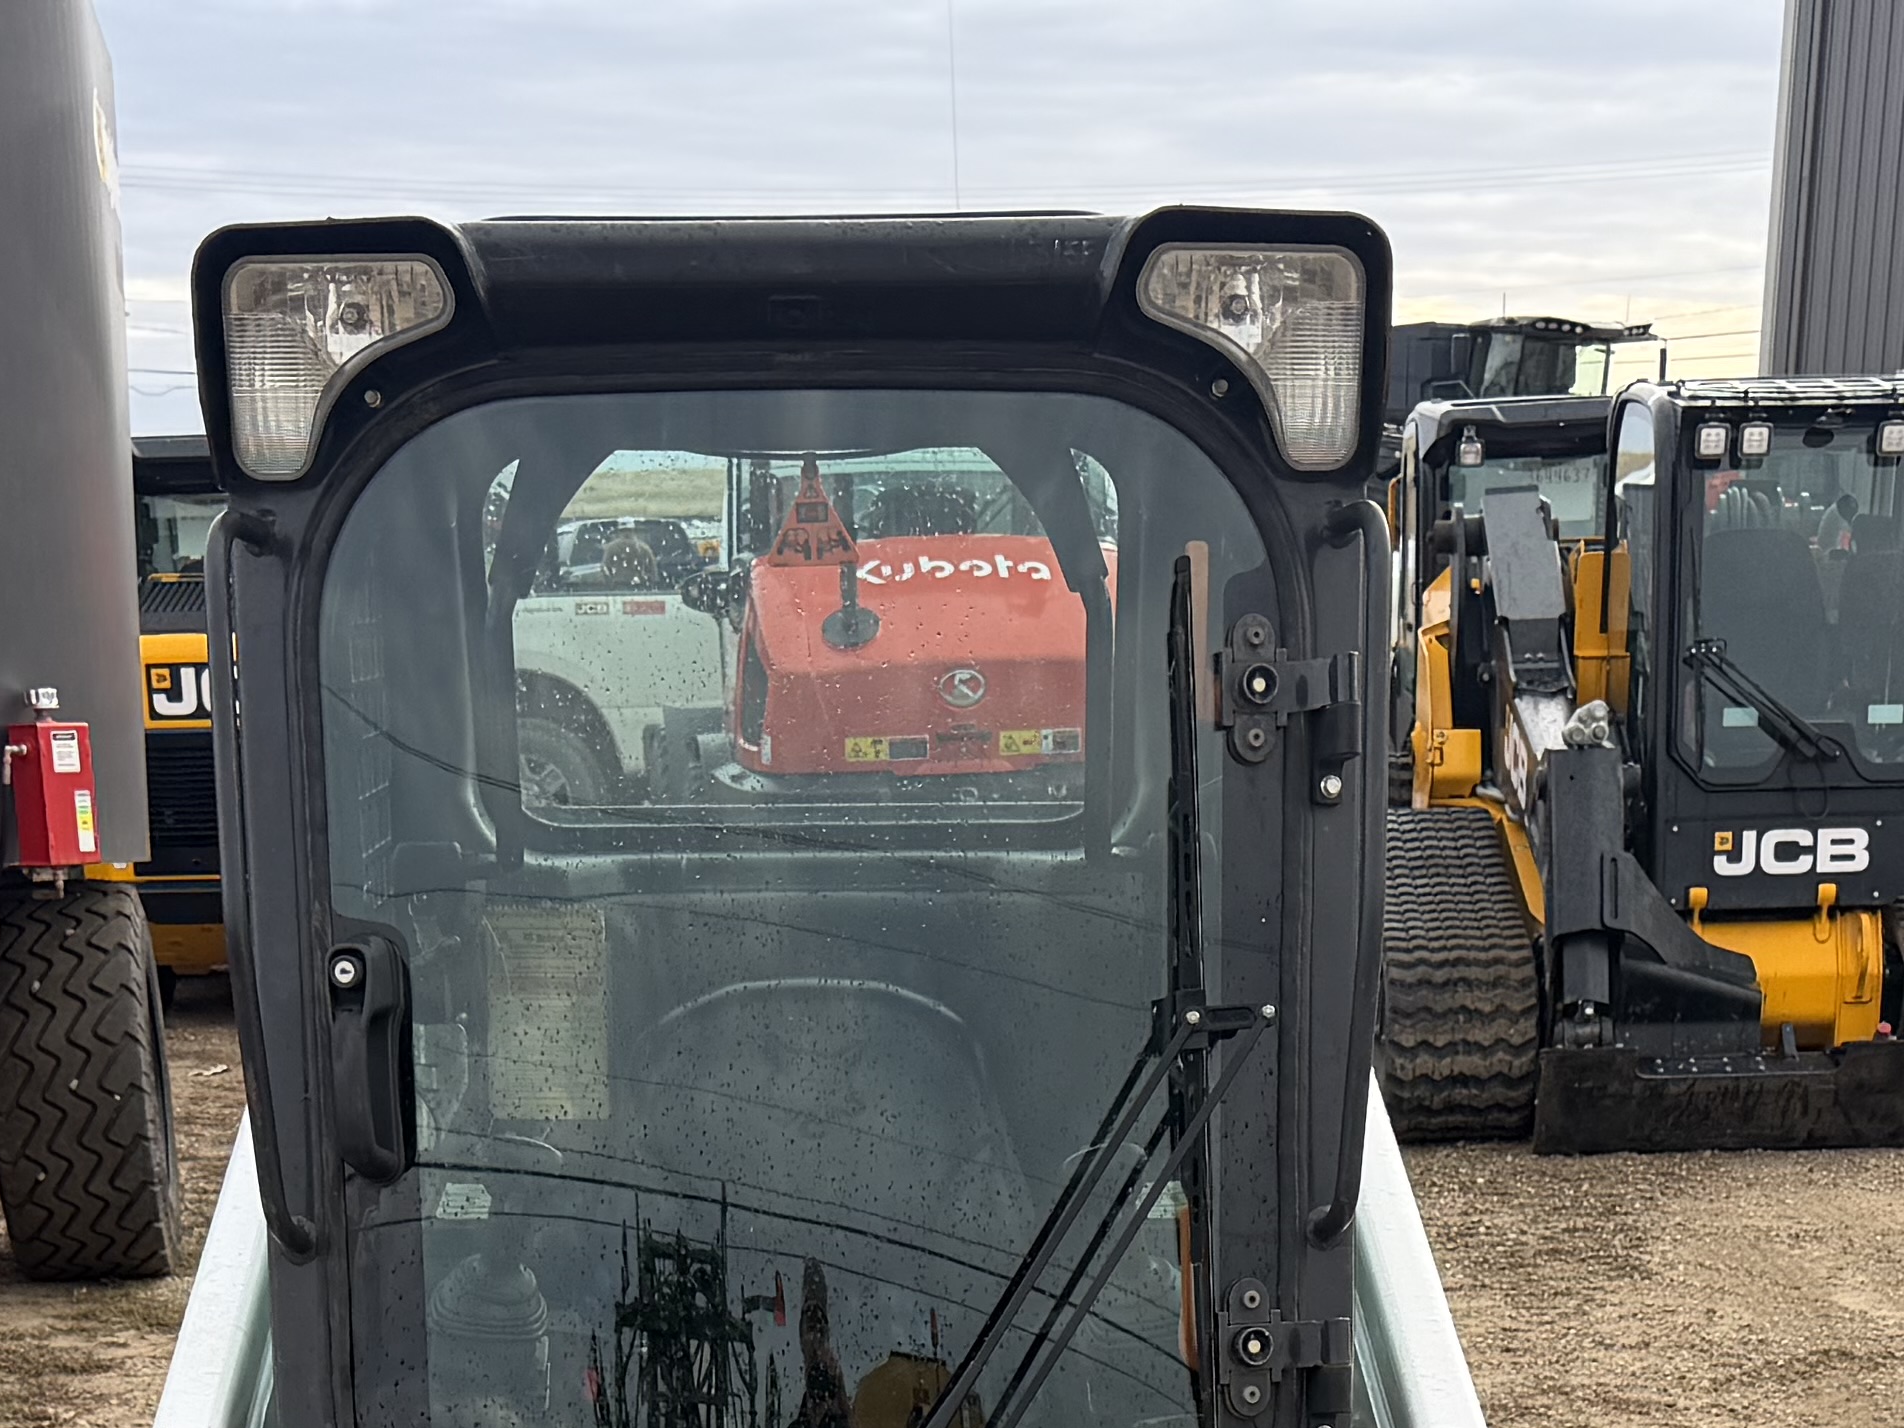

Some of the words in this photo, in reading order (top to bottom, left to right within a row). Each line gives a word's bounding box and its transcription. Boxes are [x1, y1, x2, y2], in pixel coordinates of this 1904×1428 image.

[856, 554, 1052, 584] Kubota
[577, 603, 608, 615] JCB
[1713, 827, 1870, 877] JCB
